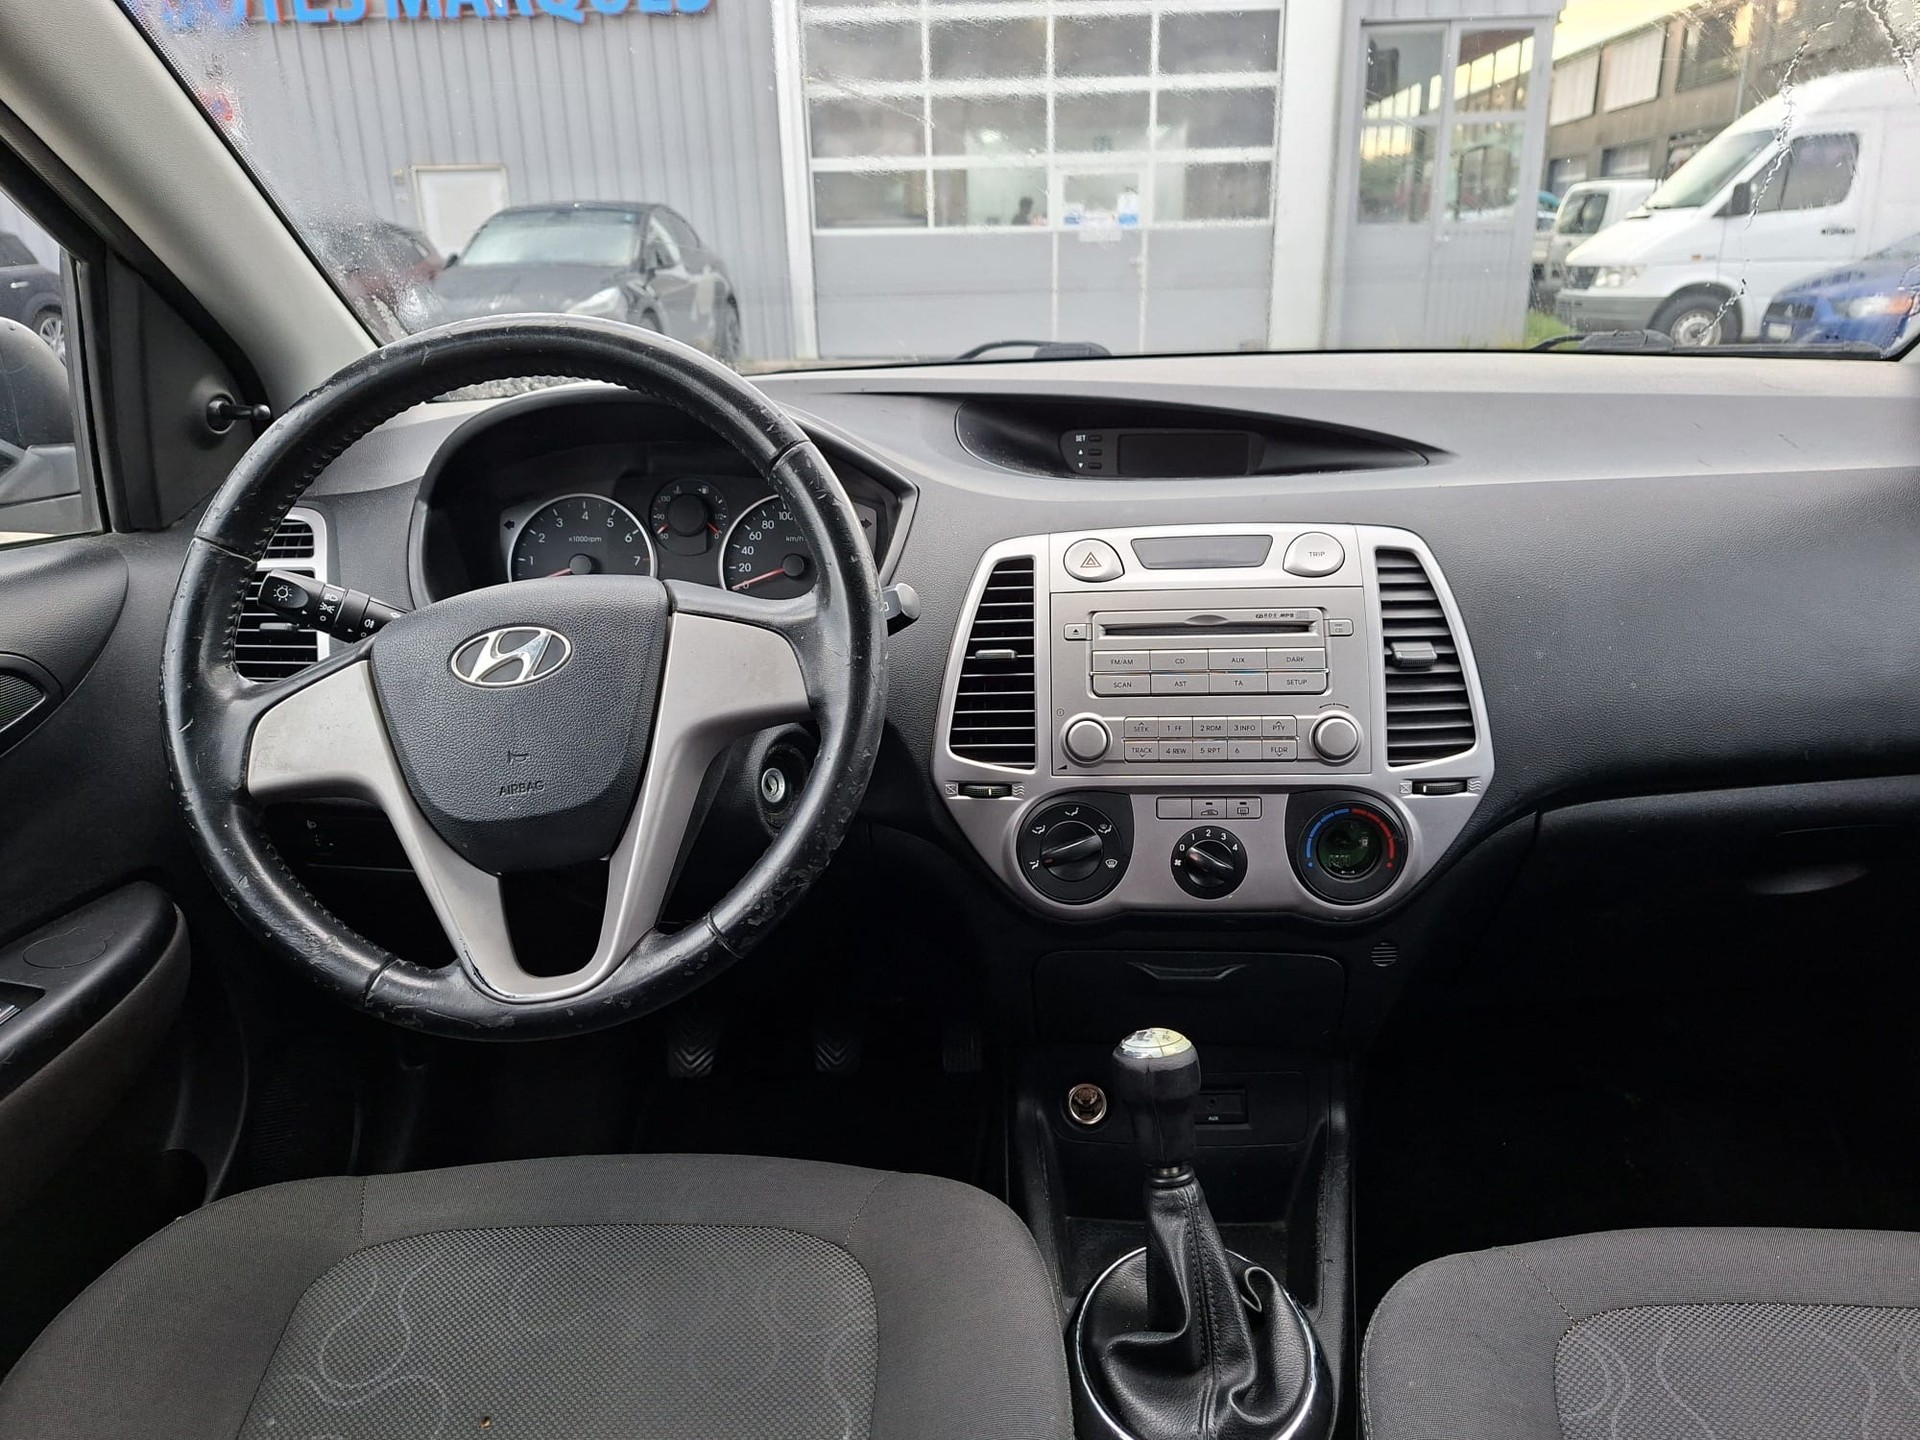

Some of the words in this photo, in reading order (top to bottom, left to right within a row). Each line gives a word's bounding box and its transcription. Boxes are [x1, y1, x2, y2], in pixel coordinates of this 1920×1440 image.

[581, 511, 589, 521] 4
[556, 518, 563, 528] 3
[607, 519, 614, 528] 5
[761, 520, 775, 530] 80
[538, 533, 546, 543] 2
[624, 534, 633, 543] 6
[748, 531, 762, 541] 60
[741, 546, 754, 555] 40
[529, 556, 534, 566] 1
[633, 556, 641, 566] 7
[738, 562, 752, 572] 20
[499, 780, 545, 796] AIRBAG
[1205, 829, 1212, 837] 2
